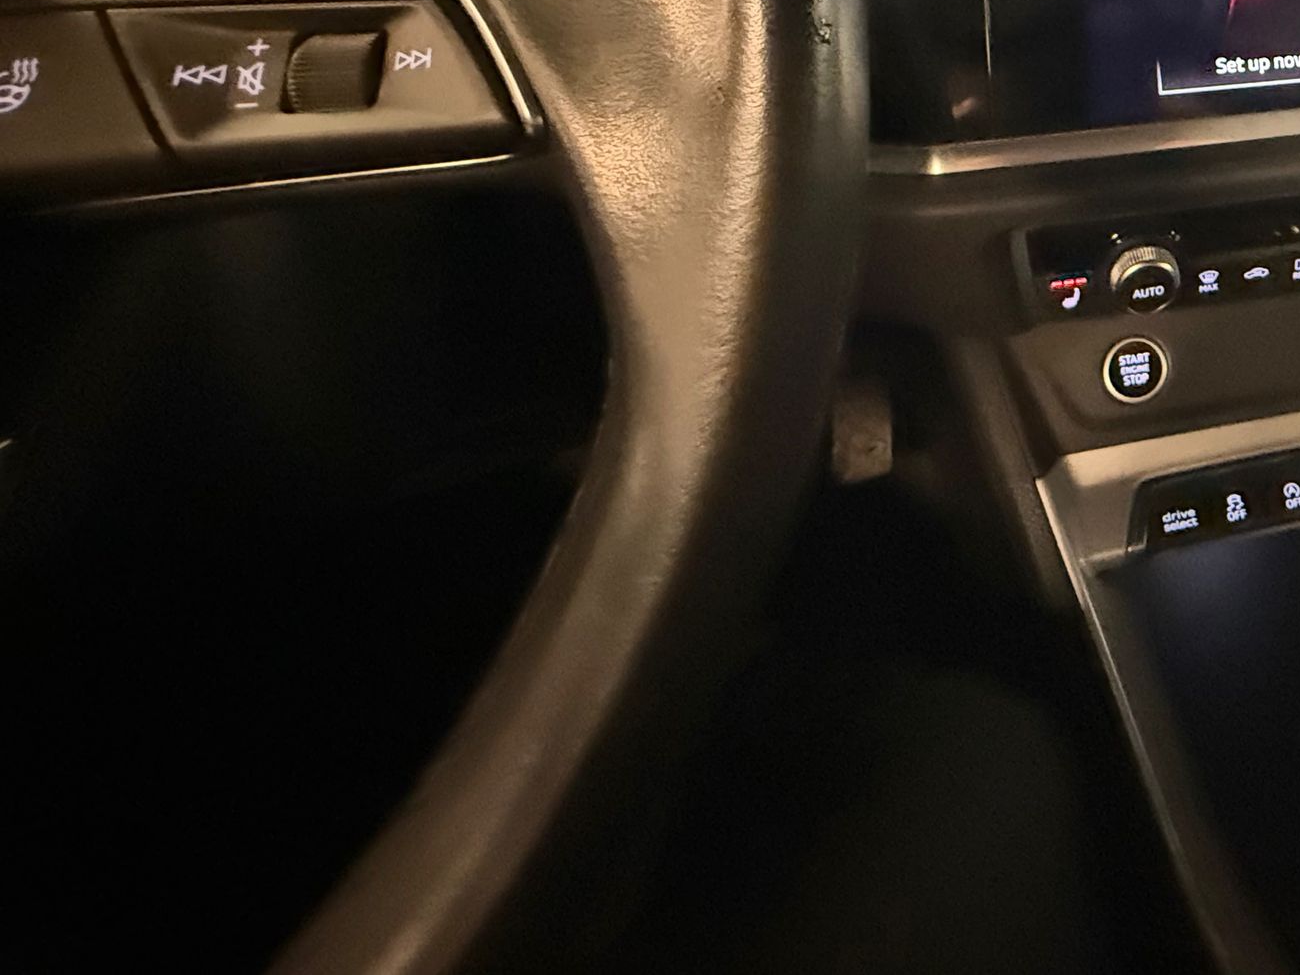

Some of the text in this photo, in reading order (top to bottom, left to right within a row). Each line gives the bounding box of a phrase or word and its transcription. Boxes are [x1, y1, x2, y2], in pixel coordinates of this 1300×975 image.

[1215, 55, 1245, 75] Set
[1248, 56, 1271, 75] up
[1132, 284, 1166, 300] AUTO
[1199, 282, 1219, 294] MAX
[1118, 351, 1150, 367] START
[1119, 364, 1150, 376] ENGINE
[1122, 373, 1150, 387] STOP
[1161, 508, 1197, 523] drive
[1226, 508, 1248, 522] OFF
[1163, 517, 1200, 533] select
